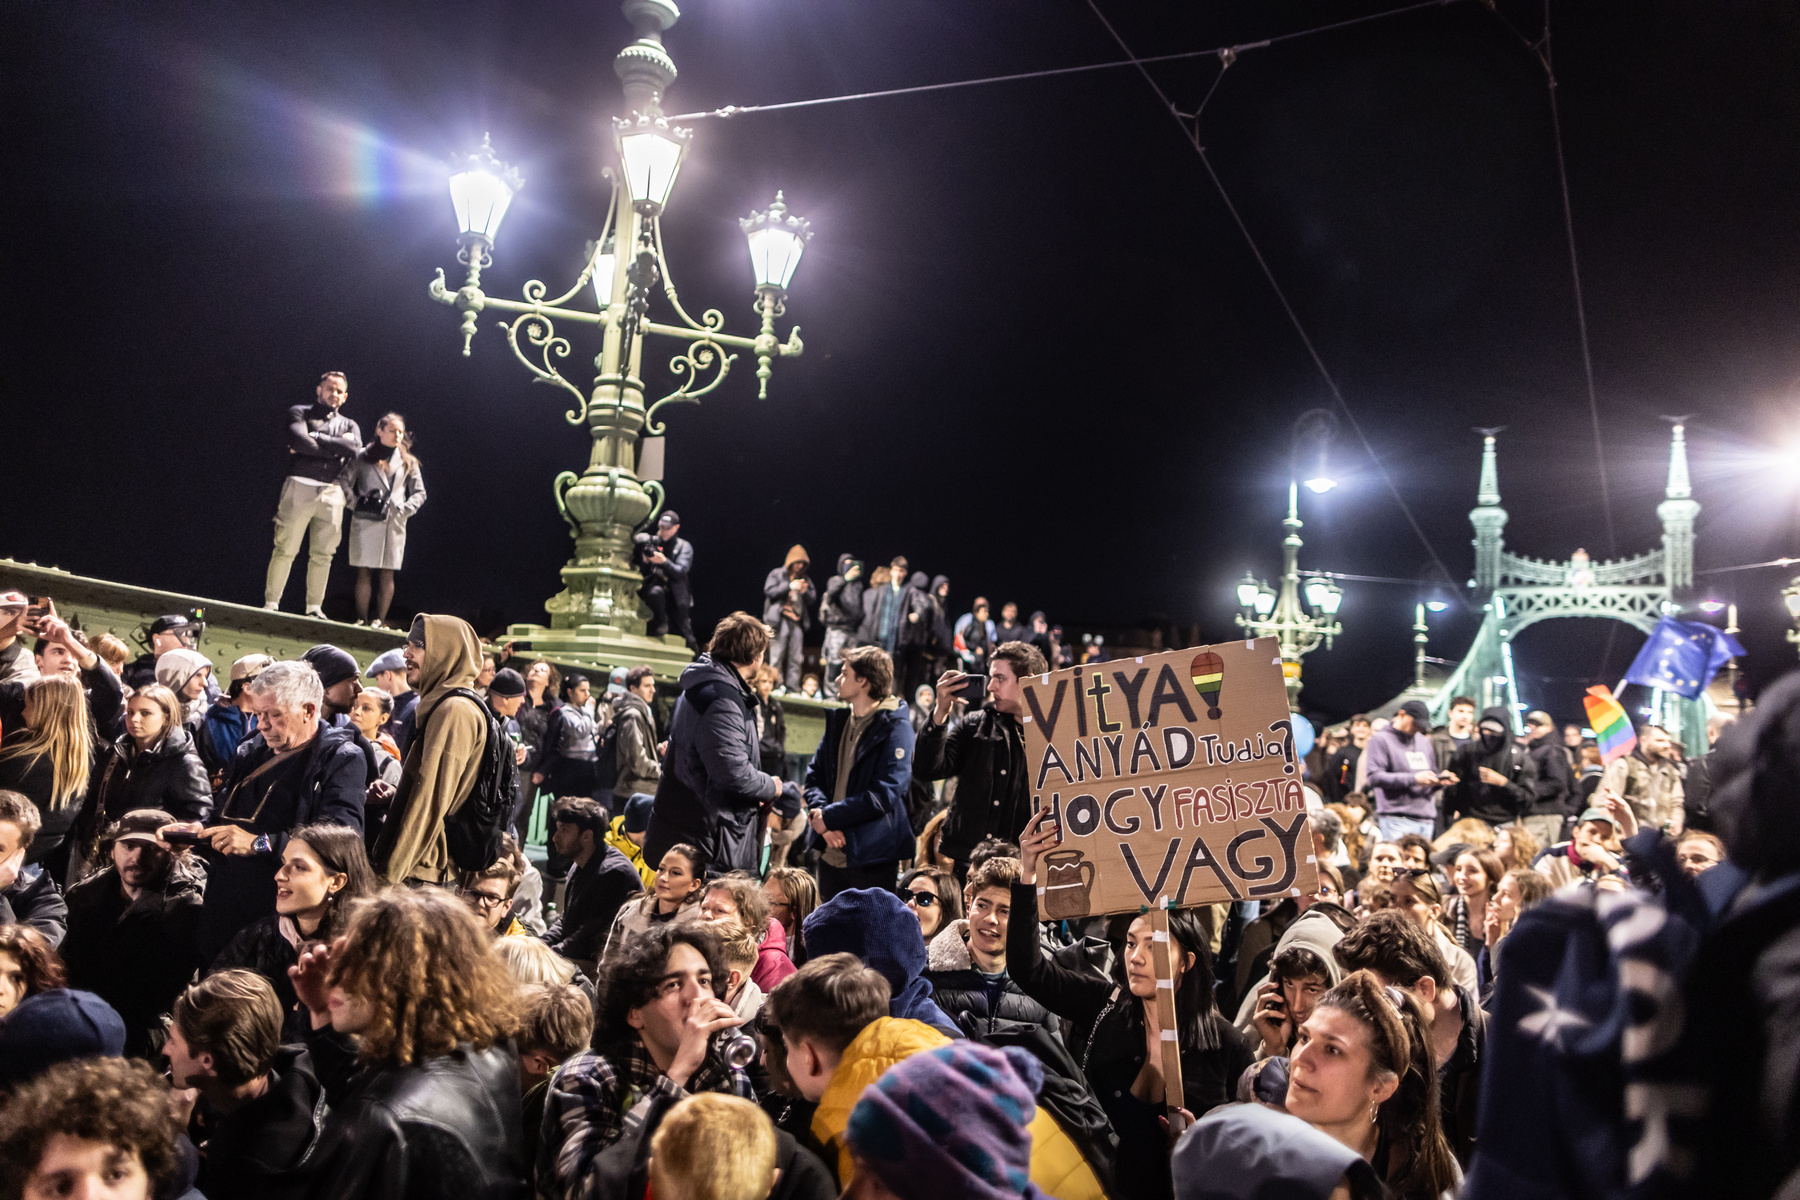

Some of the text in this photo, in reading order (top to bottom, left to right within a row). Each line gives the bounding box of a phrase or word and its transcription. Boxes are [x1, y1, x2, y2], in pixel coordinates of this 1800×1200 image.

[1036, 721, 1294, 789] ANYÁD Tudja?
[1033, 785, 1169, 843] HOGY
[1119, 813, 1308, 906] VAGY
